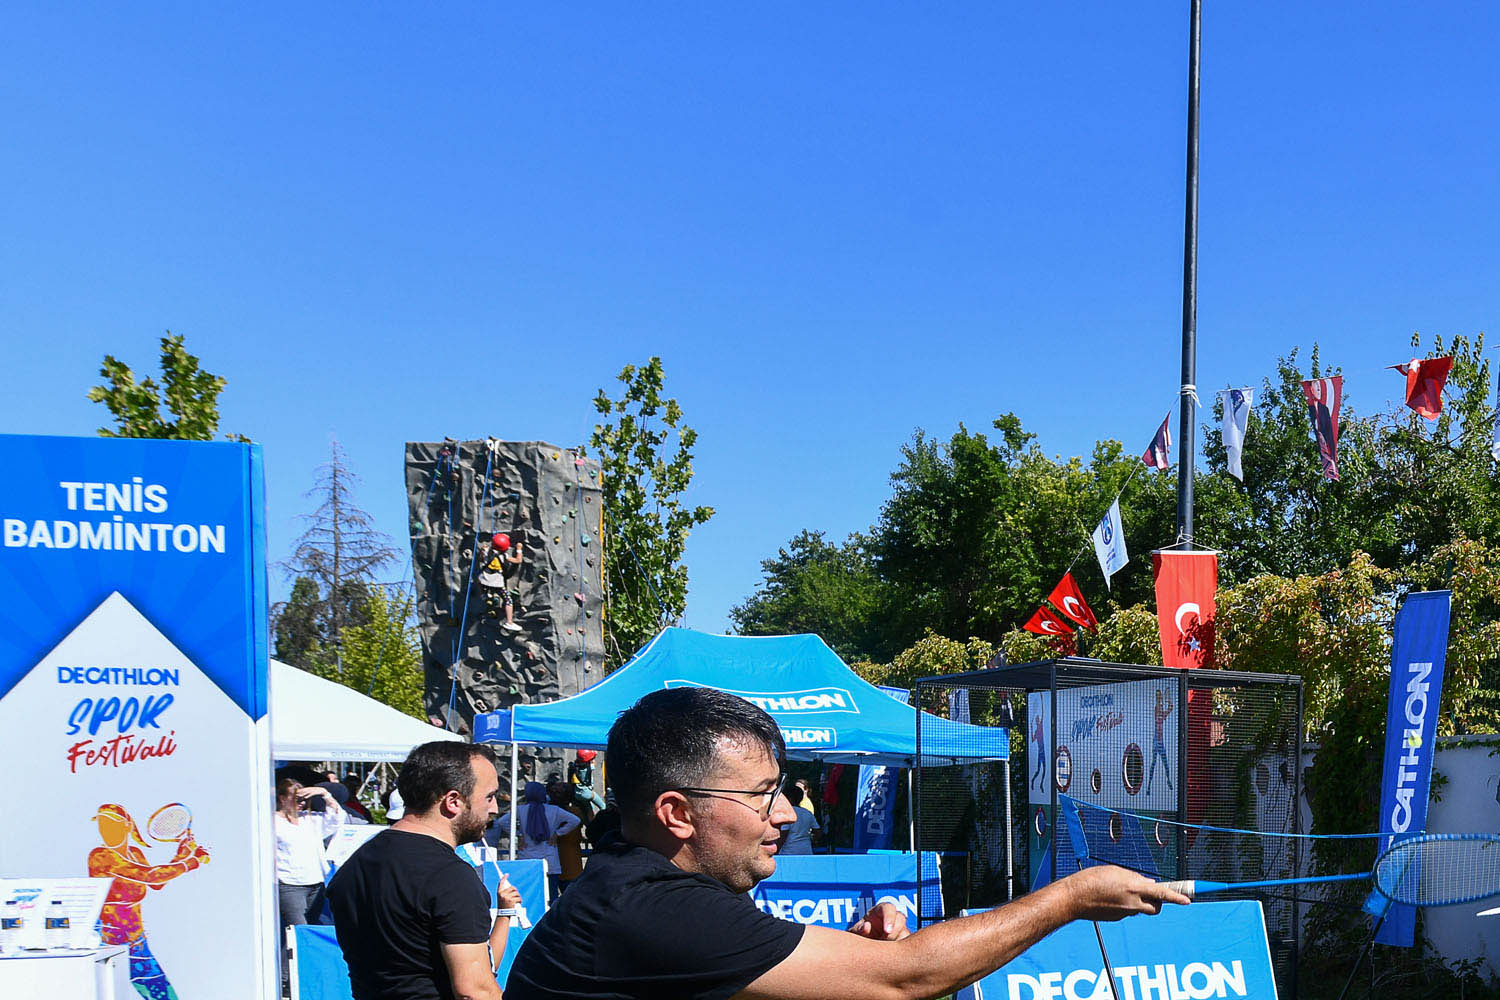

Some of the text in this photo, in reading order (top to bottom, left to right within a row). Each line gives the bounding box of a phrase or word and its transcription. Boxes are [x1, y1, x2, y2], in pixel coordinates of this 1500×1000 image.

[60, 477, 168, 513] TENİS
[4, 515, 226, 553] BADMİNTON
[57, 666, 179, 686] DECATHLON
[66, 693, 174, 736] SPOR
[742, 693, 846, 710] THLON
[67, 730, 177, 773] Festivali
[1388, 662, 1432, 850] CATHLON
